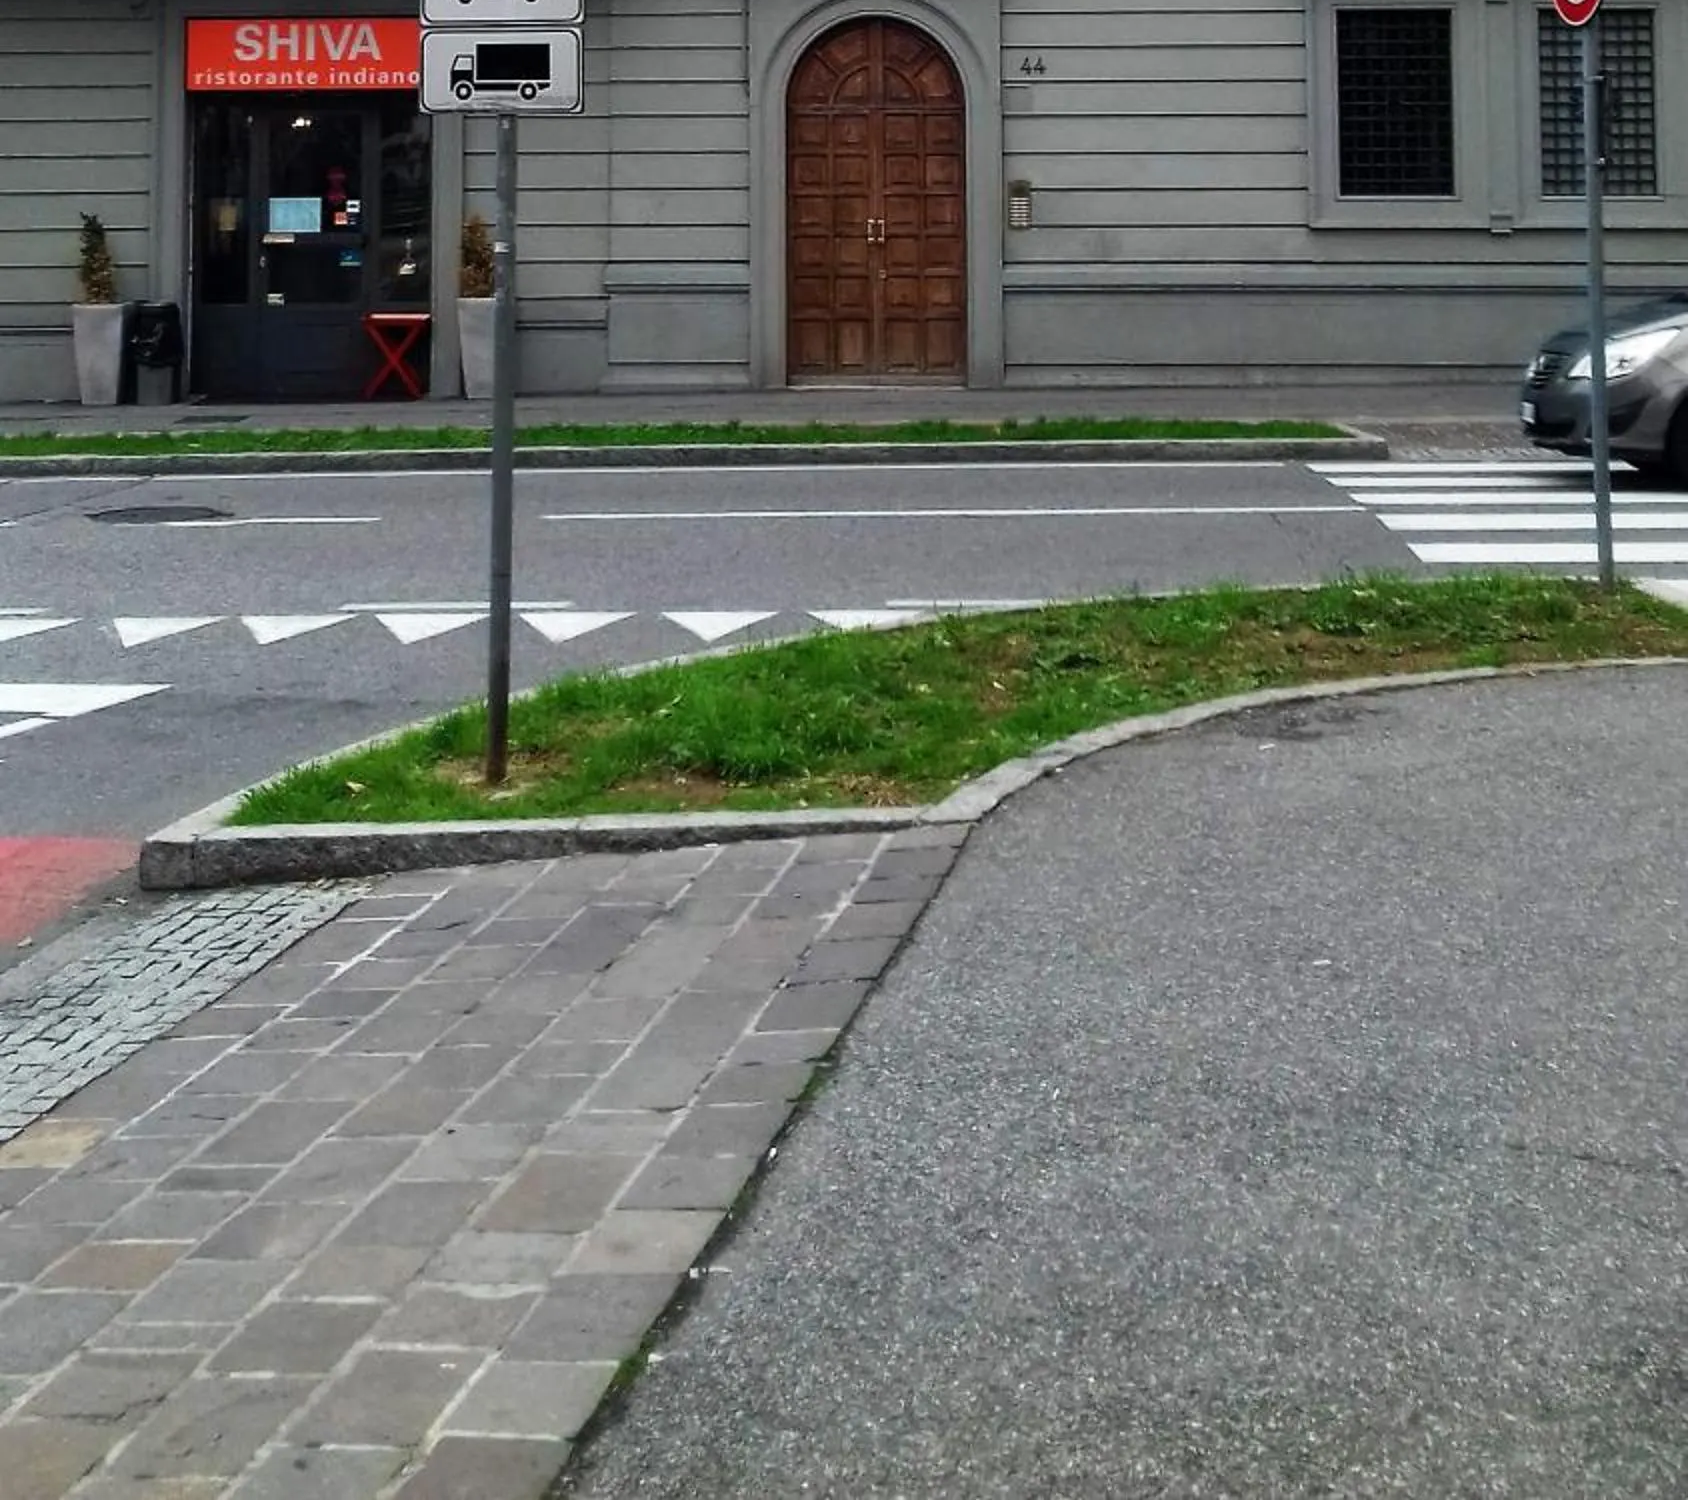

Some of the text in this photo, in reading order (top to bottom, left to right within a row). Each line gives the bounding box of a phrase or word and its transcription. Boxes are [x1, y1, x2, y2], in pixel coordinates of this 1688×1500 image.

[234, 23, 383, 62] SHIVA
[1020, 56, 1047, 75] 44
[194, 67, 421, 86] ristorante indiano
